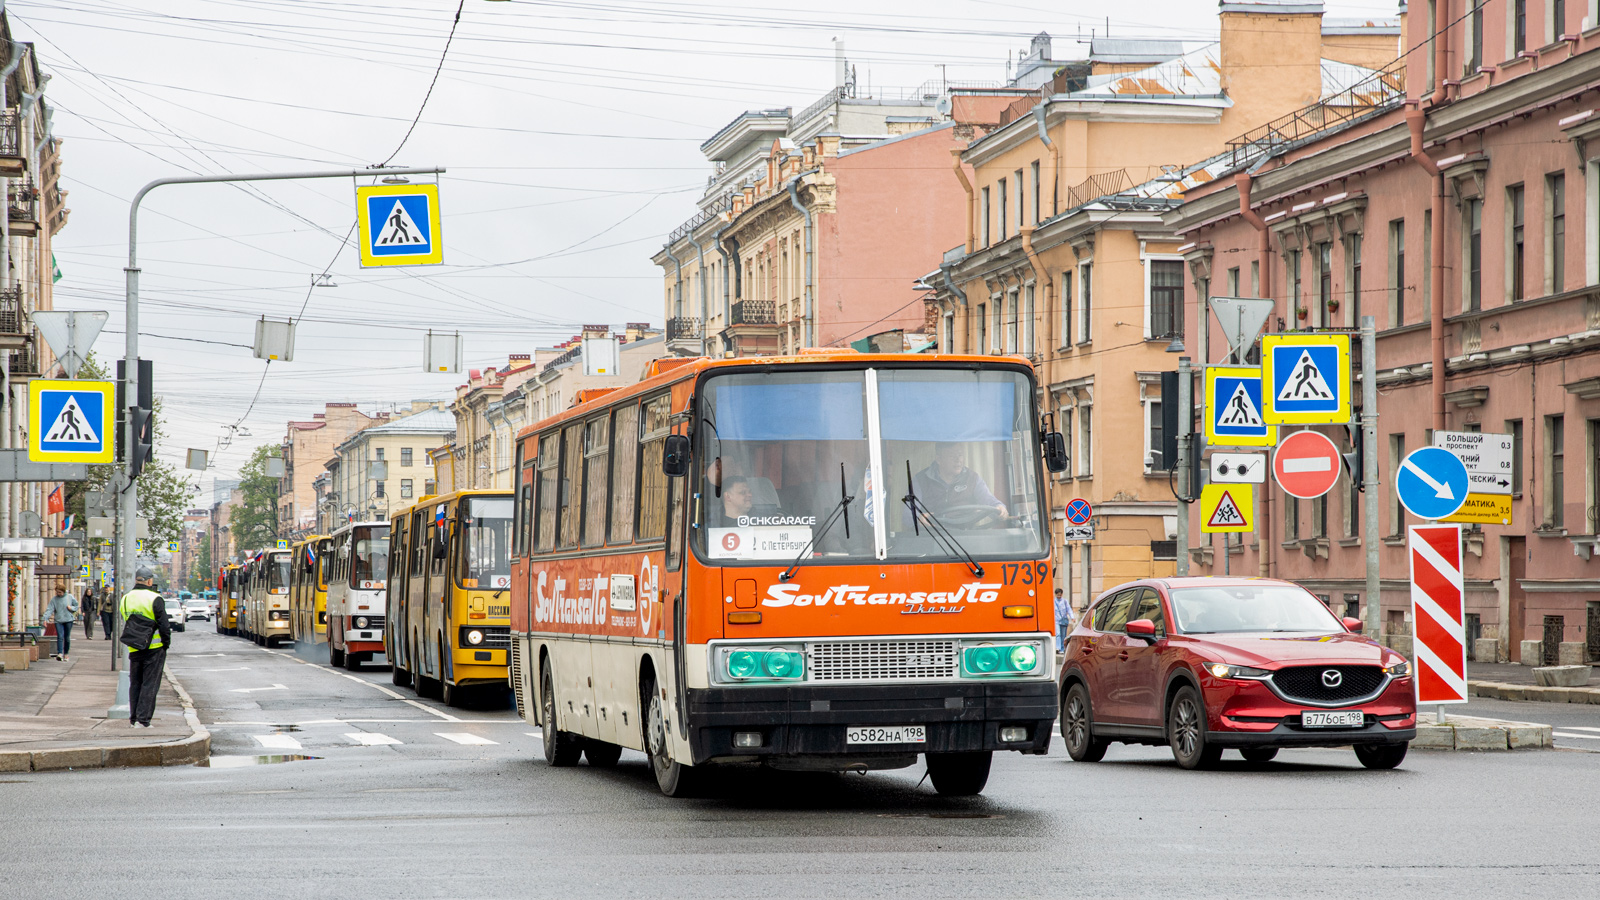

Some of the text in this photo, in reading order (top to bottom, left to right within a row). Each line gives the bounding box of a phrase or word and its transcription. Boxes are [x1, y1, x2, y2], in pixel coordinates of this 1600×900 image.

[1446, 434, 1484, 444] БОЛЬШОЙ
[1500, 441, 1511, 449] 0.3
[1460, 453, 1480, 463] ДНИЙ
[1500, 461, 1511, 469] 0.8
[1469, 475, 1497, 483] ЧЕСКИЙ
[1464, 500, 1496, 508] МАТИКА
[1500, 506, 1510, 514] 3,5
[749, 516, 816, 525] CHKGARAGE
[779, 533, 789, 541] НА
[727, 536, 735, 549] 5
[1001, 562, 1049, 585] 1739
[488, 605, 510, 616] ПАССАЖИ
[900, 603, 966, 615] Ikarus
[905, 656, 945, 666] 250
[1306, 712, 1362, 724] В776ОЕ 198
[851, 727, 923, 742] О582НА 198
